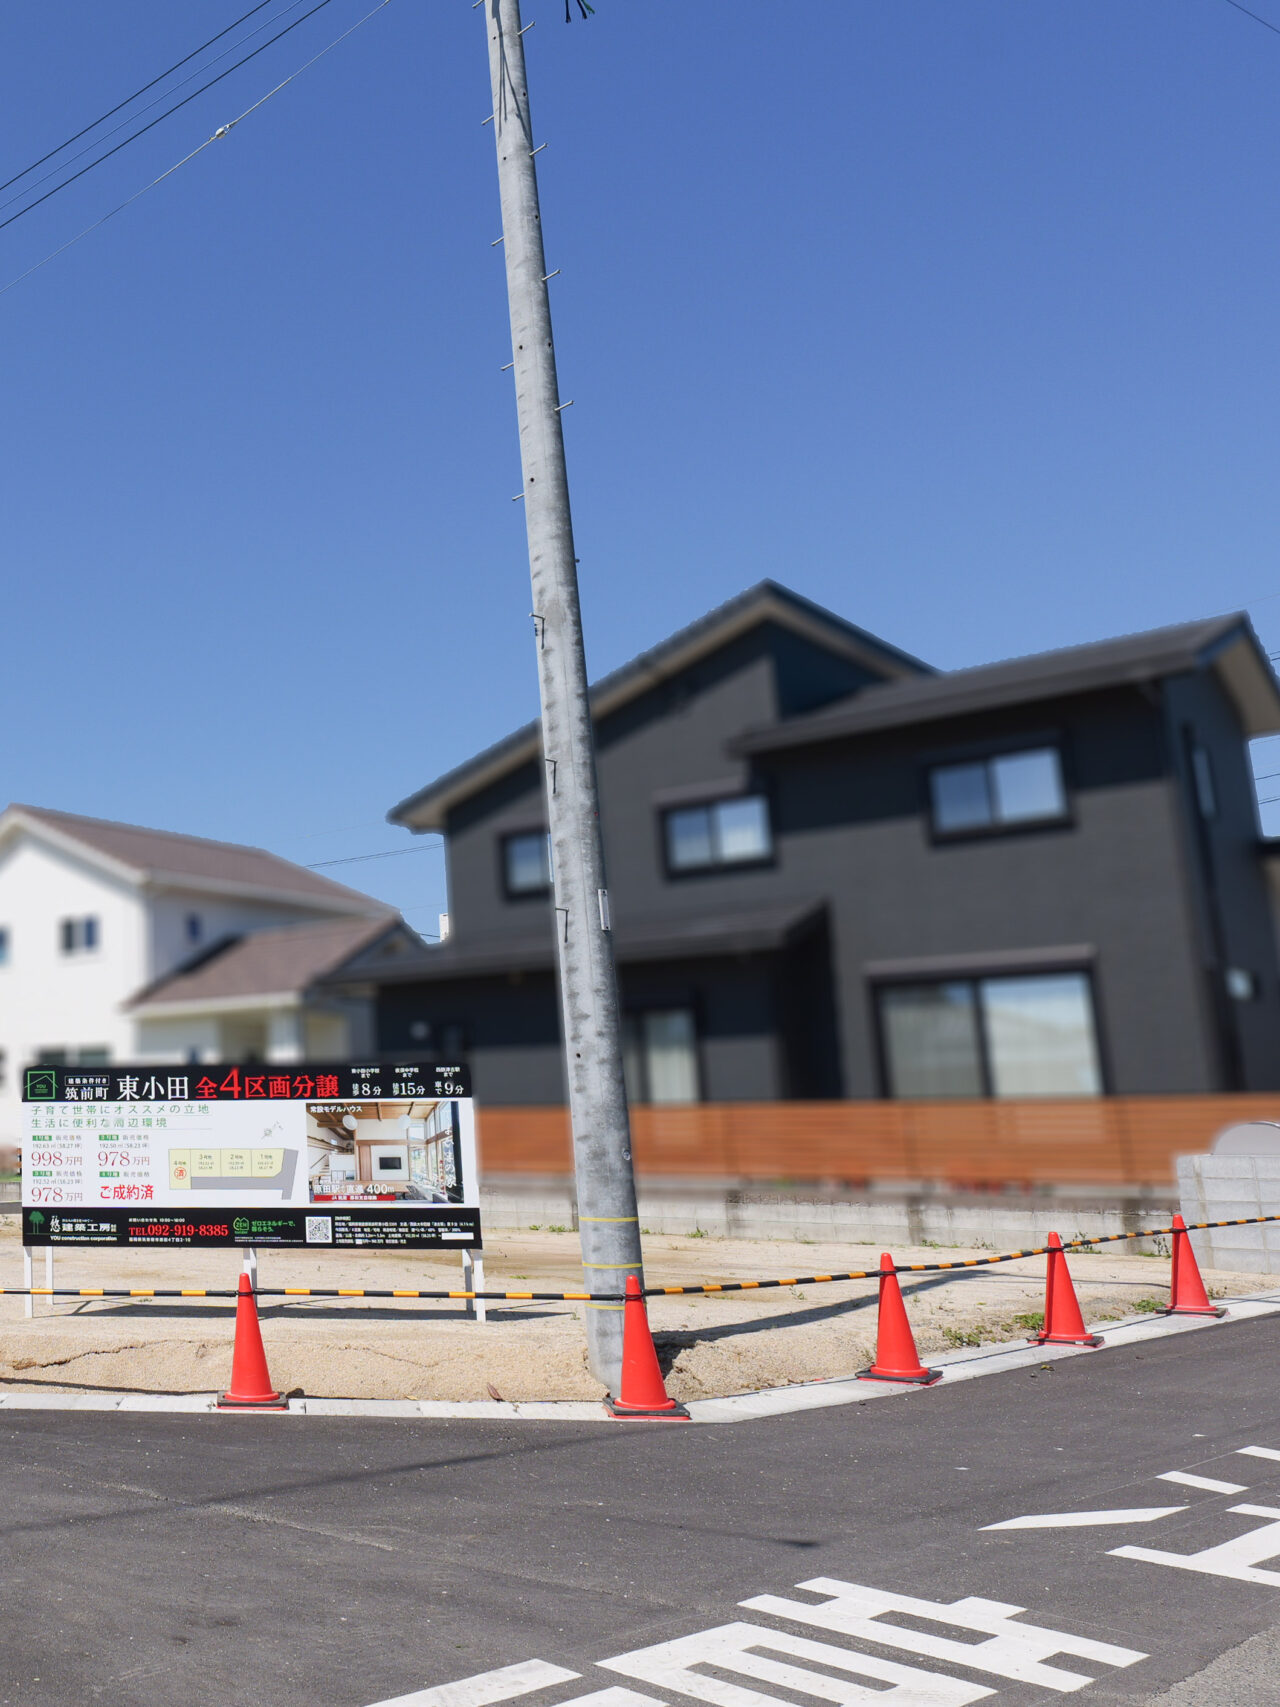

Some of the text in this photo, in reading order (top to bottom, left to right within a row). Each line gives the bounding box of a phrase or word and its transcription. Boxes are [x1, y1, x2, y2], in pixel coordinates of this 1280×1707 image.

[65, 1066, 339, 1101] 筑前町 東小田 全4区画分譲
[31, 1104, 210, 1115] 子育て世帯にオススメの立地
[31, 1117, 167, 1129] 生活に便利な周辺環境
[31, 1151, 83, 1167] 998万円
[98, 1150, 150, 1167] 978万円
[31, 1186, 83, 1203] 978万円
[99, 1184, 154, 1200] ご成約済
[128, 1224, 229, 1236] TEL092-919-8385
